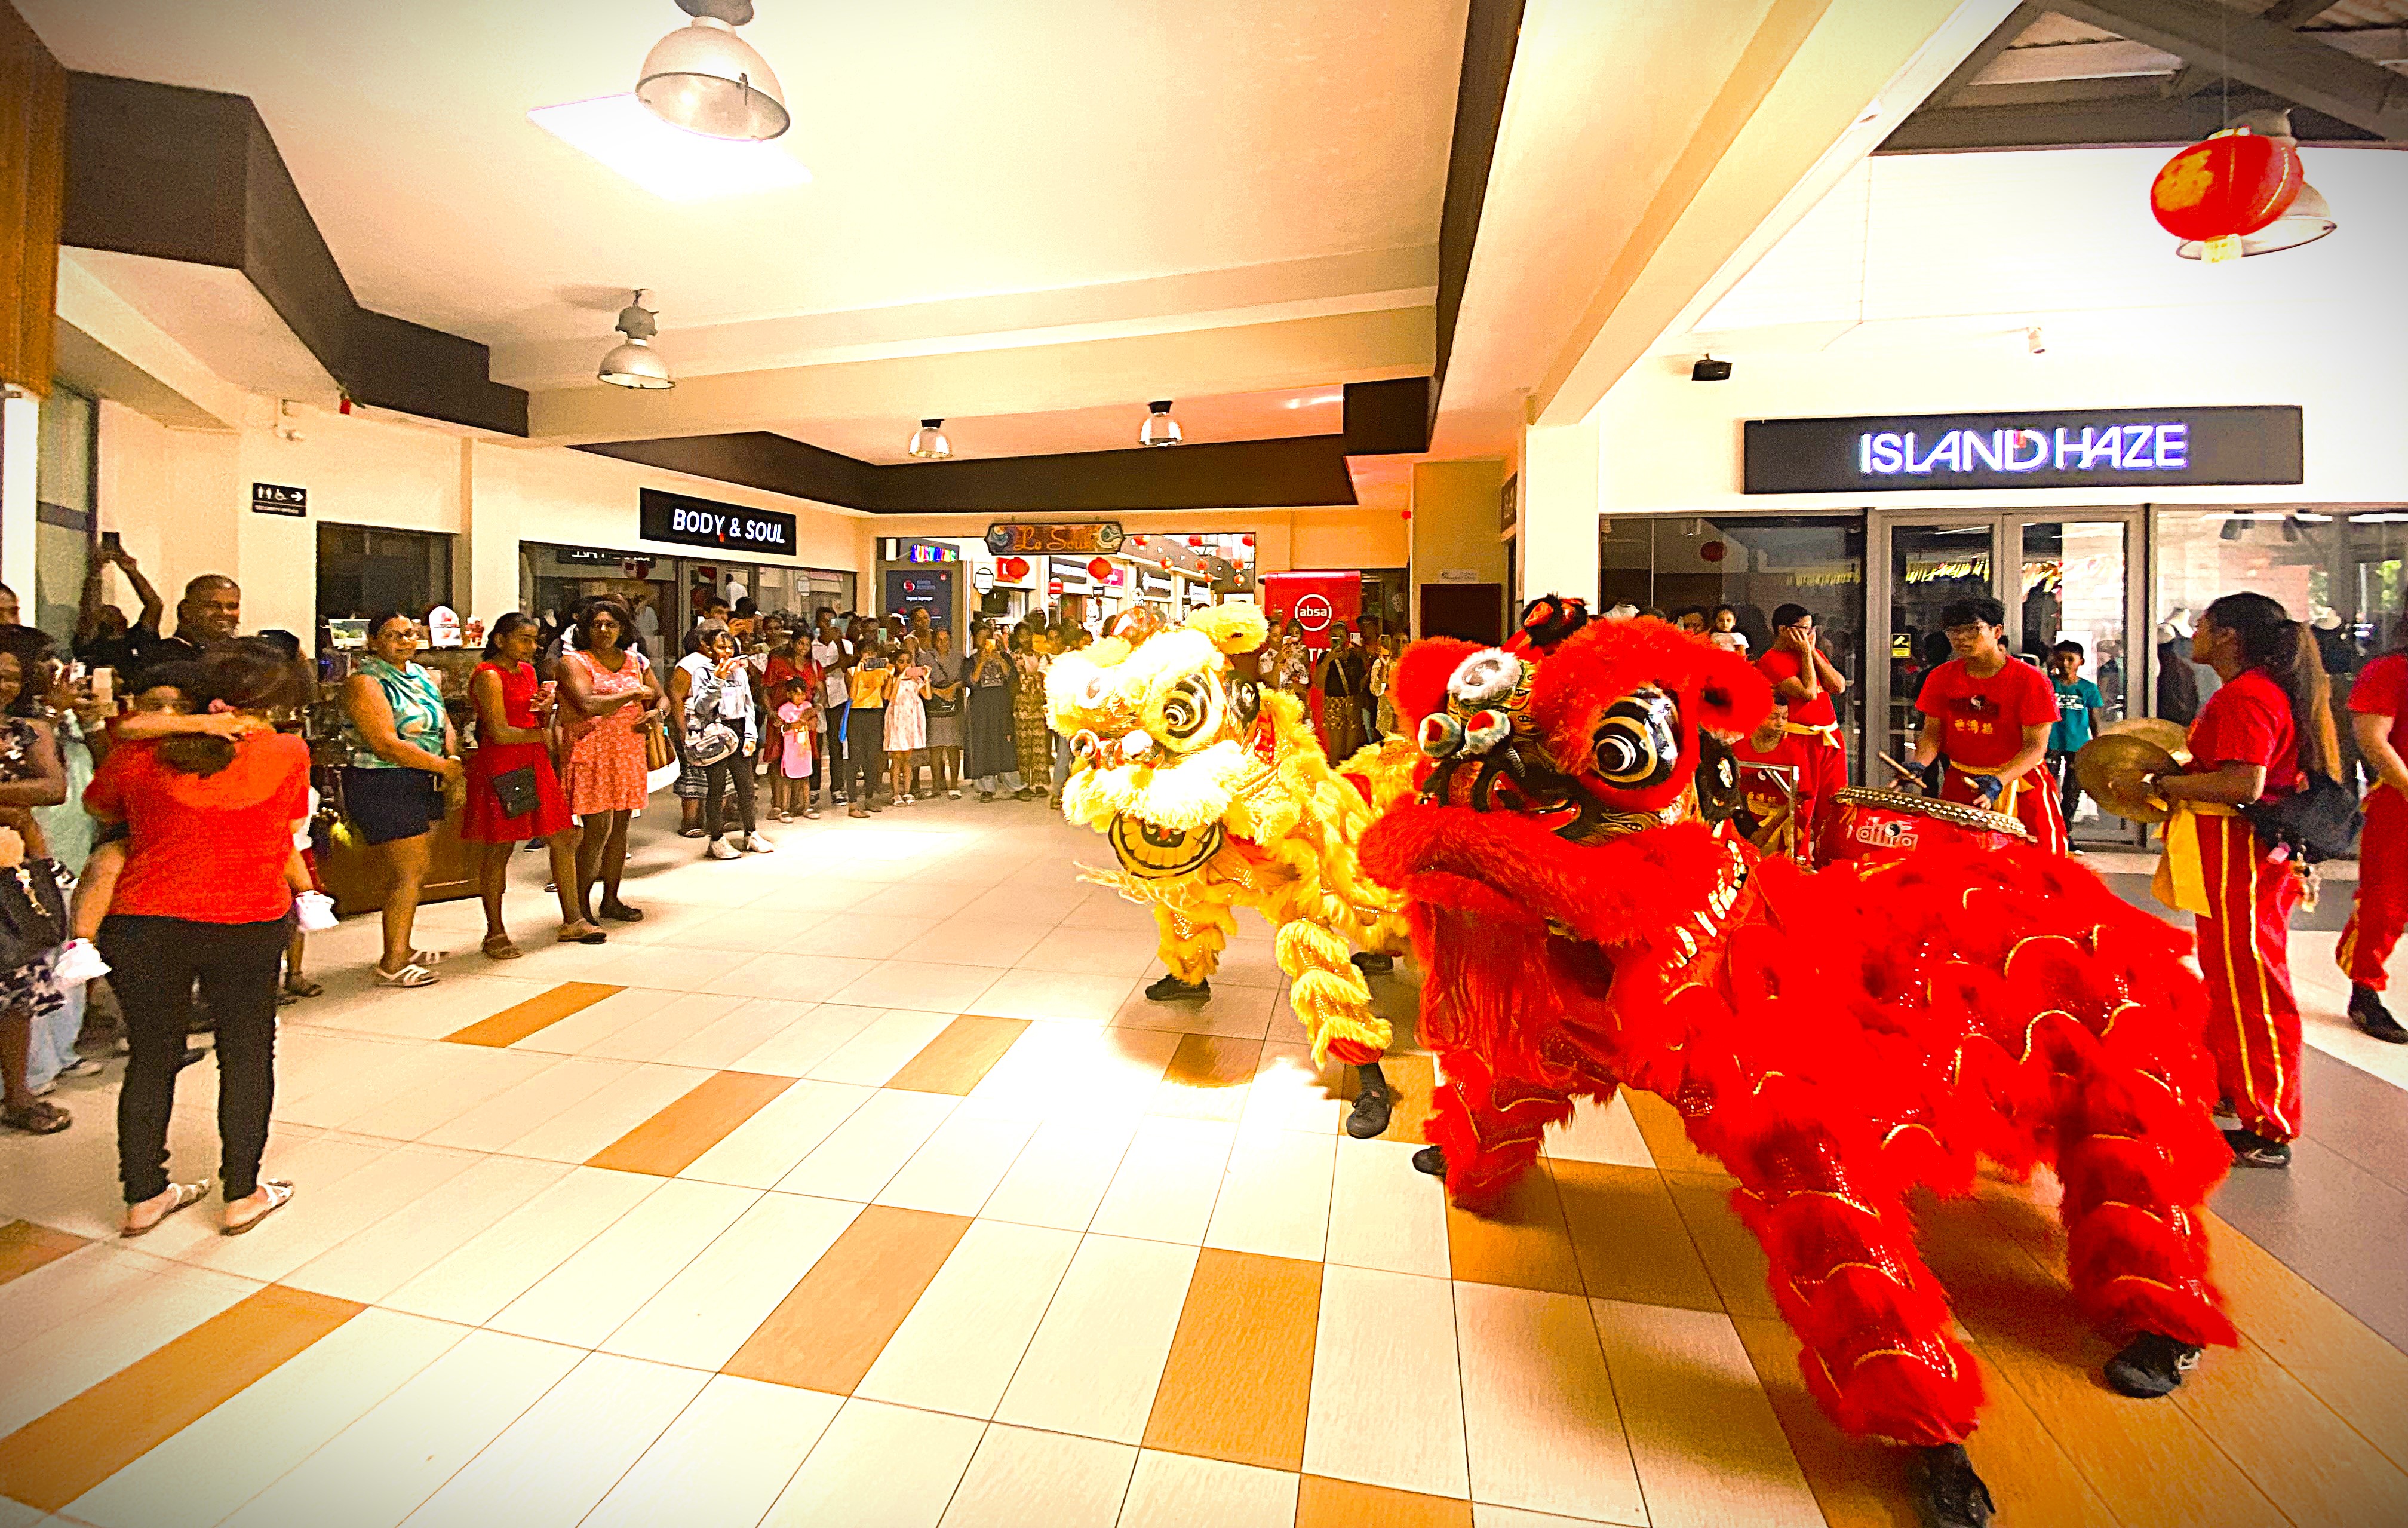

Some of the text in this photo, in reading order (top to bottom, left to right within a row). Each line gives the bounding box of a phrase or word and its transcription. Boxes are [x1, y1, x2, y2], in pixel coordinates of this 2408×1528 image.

[1860, 424, 2189, 474] ISLAND HAZE
[672, 508, 786, 544] BODY & SOUL
[1014, 527, 1042, 550] Le
[1299, 605, 1328, 617] absa
